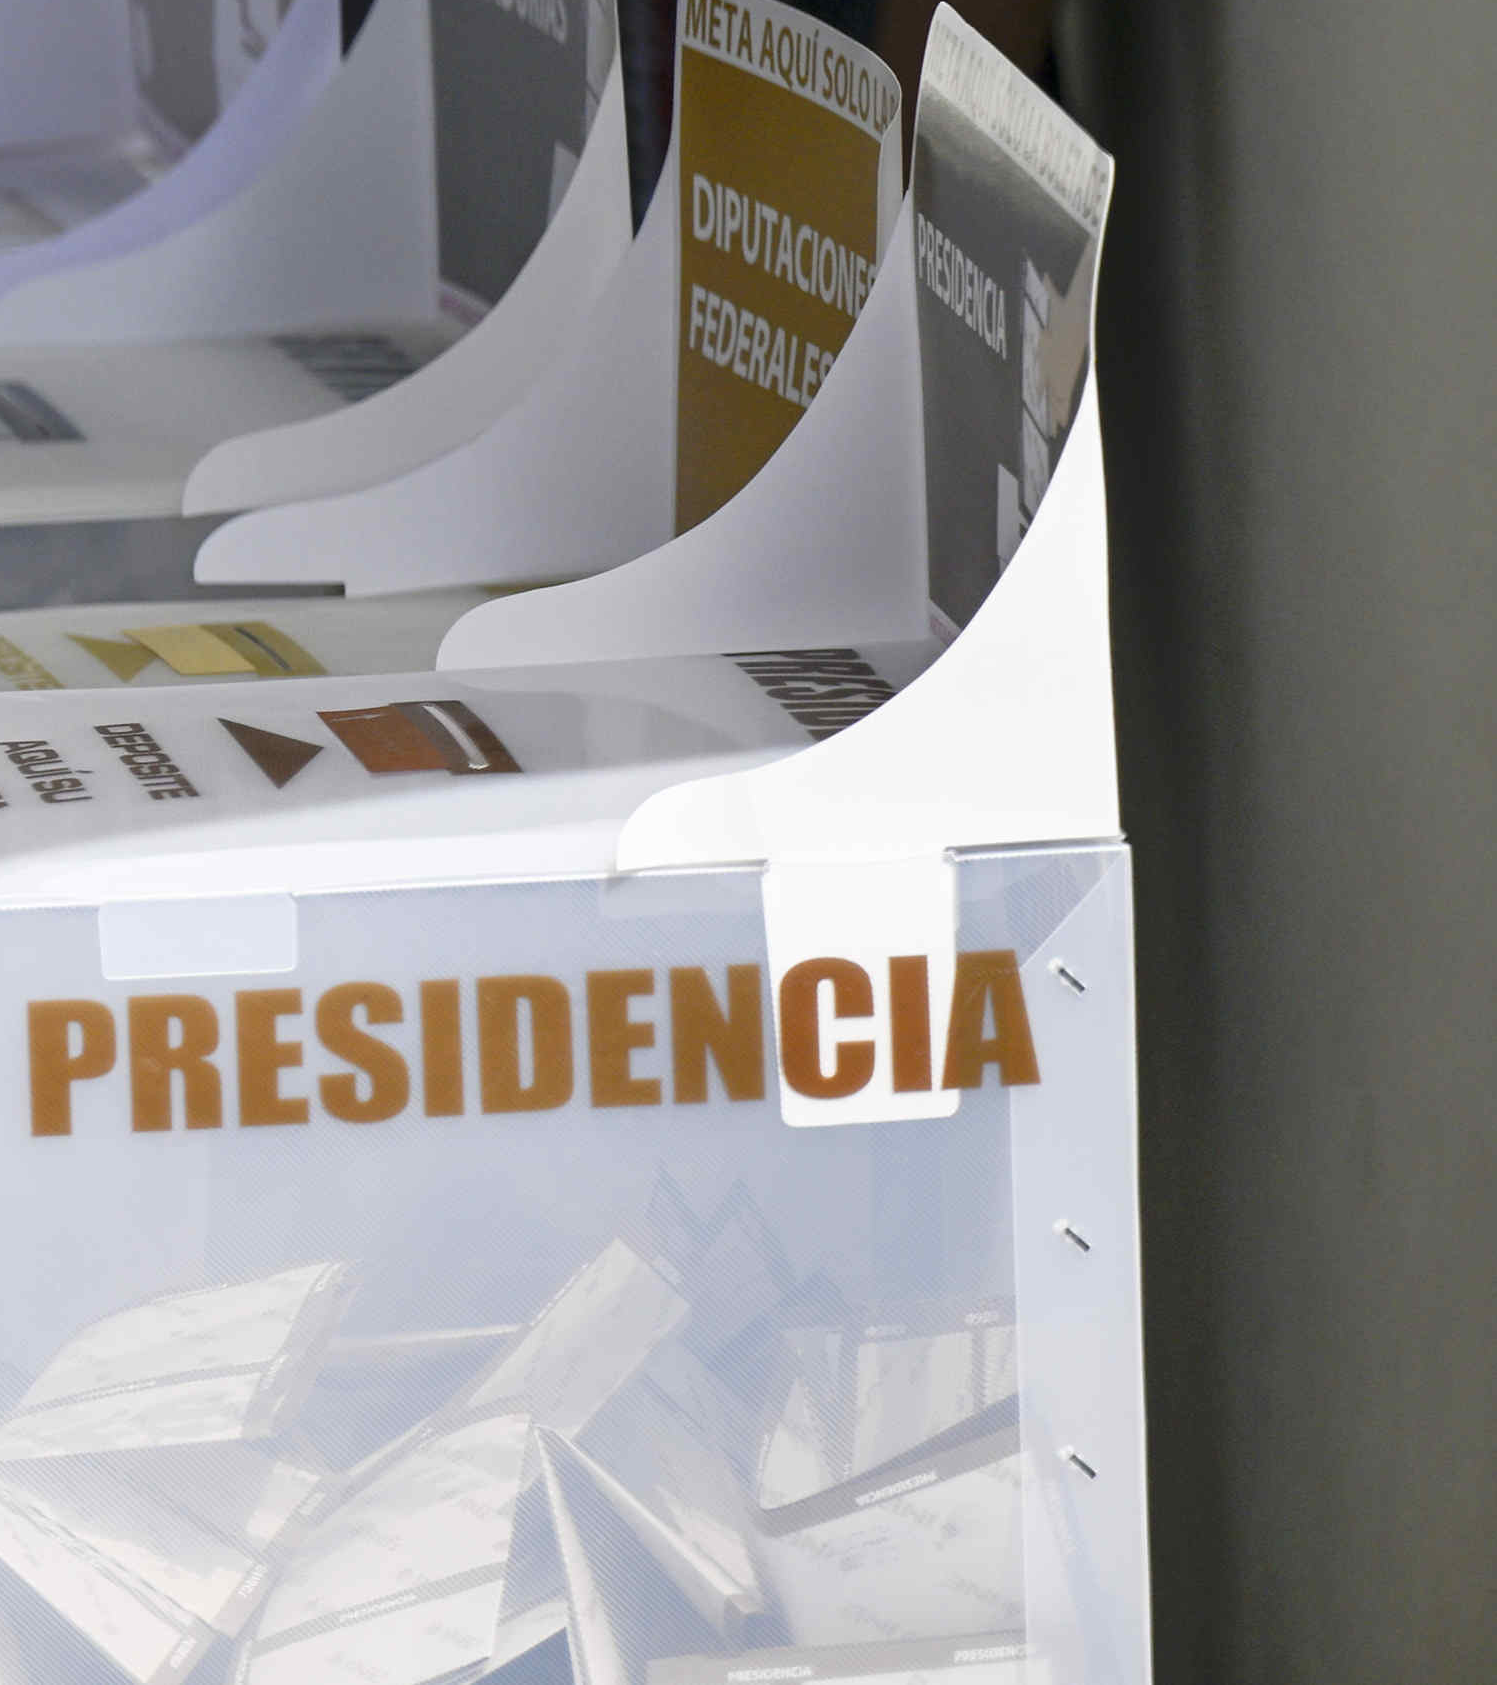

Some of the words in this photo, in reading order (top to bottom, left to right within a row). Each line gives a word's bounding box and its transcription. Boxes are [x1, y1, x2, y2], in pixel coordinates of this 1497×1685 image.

[759, 17, 820, 90] AQUÍ
[822, 47, 870, 123] SOLO
[916, 211, 1008, 361] PRESIDENCIA
[31, 777, 93, 804] SU
[92, 721, 201, 801] DEPOSITE
[26, 948, 1042, 1139] PRESIDENCIA
